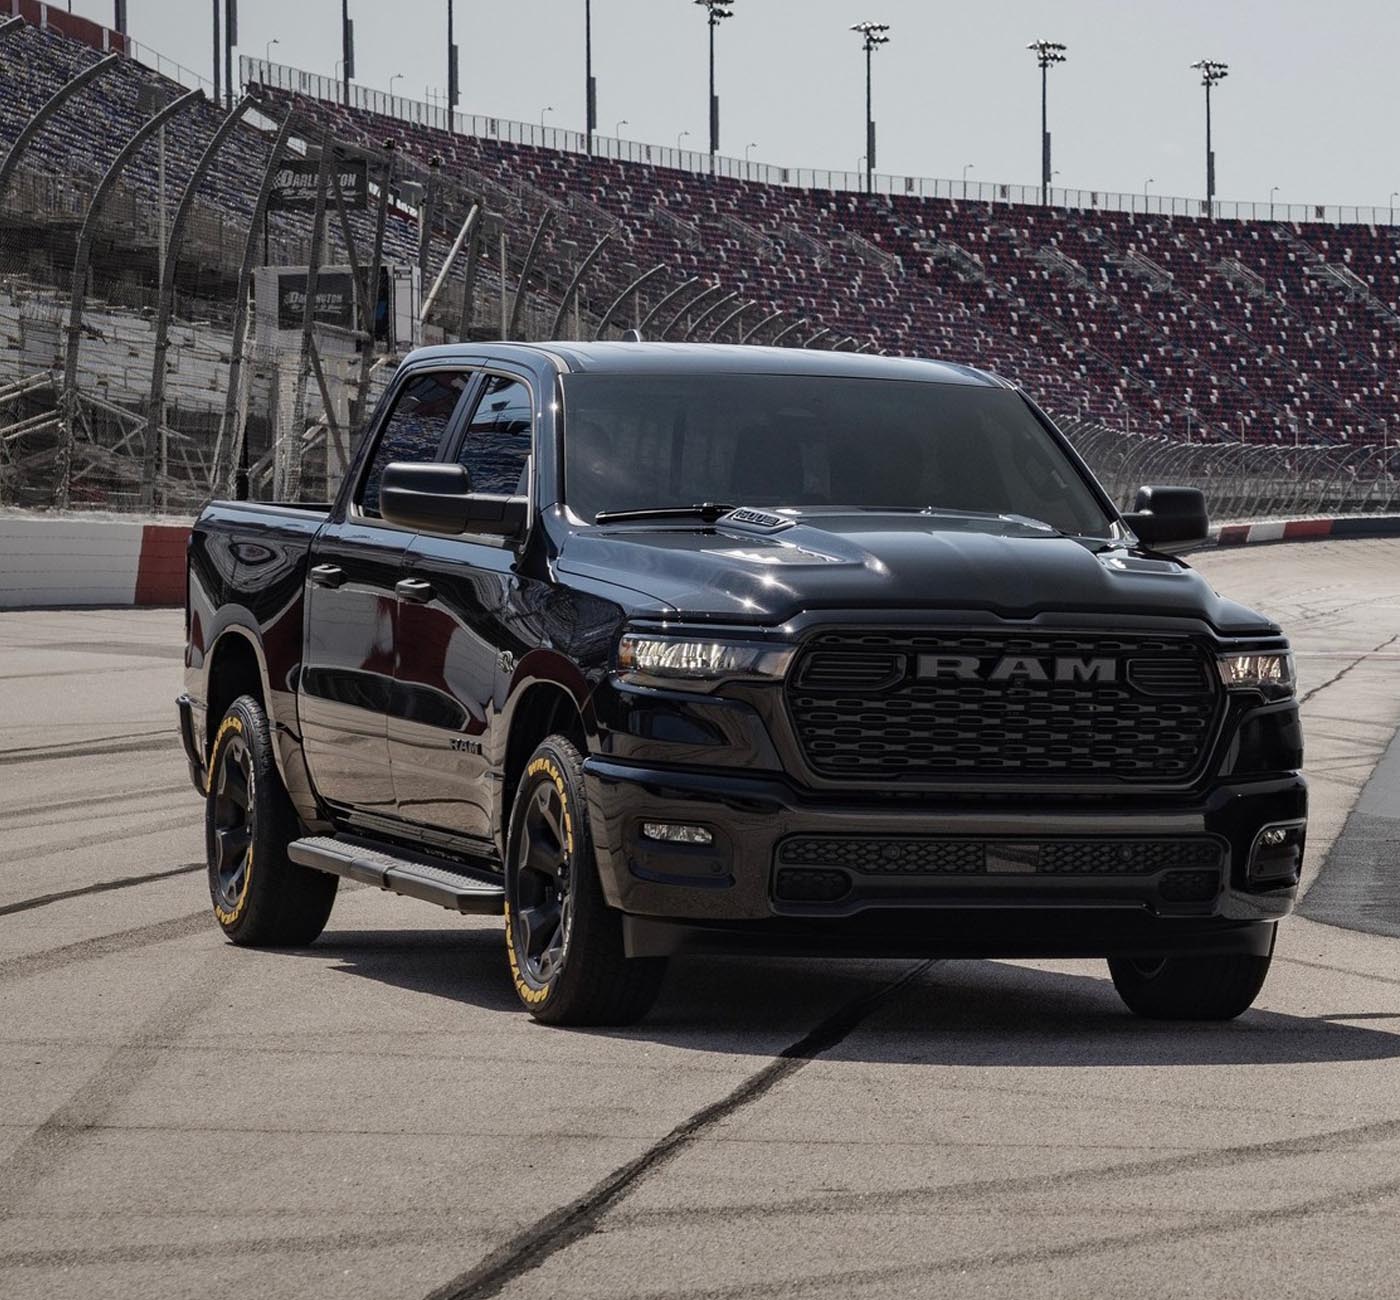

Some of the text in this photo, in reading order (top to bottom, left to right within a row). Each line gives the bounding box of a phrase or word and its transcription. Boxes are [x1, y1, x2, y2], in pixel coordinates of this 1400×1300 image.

[279, 169, 357, 187] DARLION
[917, 654, 1117, 682] RAM
[449, 738, 481, 755] RAM
